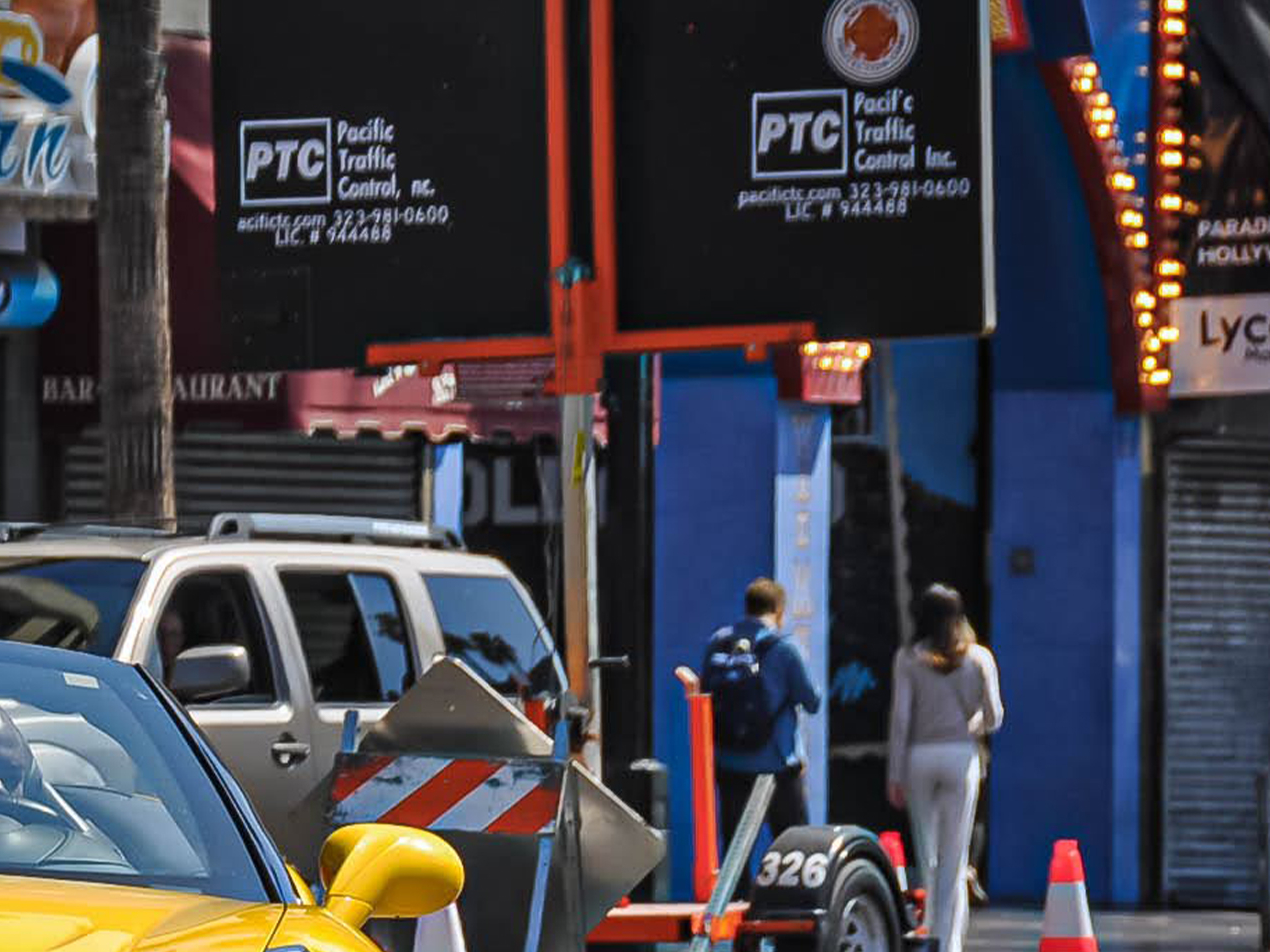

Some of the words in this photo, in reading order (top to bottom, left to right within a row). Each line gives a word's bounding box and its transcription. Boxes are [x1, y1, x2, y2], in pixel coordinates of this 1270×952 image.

[337, 116, 394, 144] Pacific
[758, 111, 841, 154] PTC
[855, 116, 915, 144] Traffic
[246, 138, 325, 181] PTC
[338, 146, 397, 172] Traffic
[926, 146, 957, 169] Inc.
[849, 177, 970, 200] 323-981-0600
[333, 205, 449, 230] 323-981-0600
[840, 199, 907, 218] 944488
[326, 226, 392, 245] 944488
[1198, 216, 1270, 238] PARAD
[1201, 310, 1270, 354] Lyc
[43, 376, 96, 401] BAR
[756, 850, 829, 889] 326
